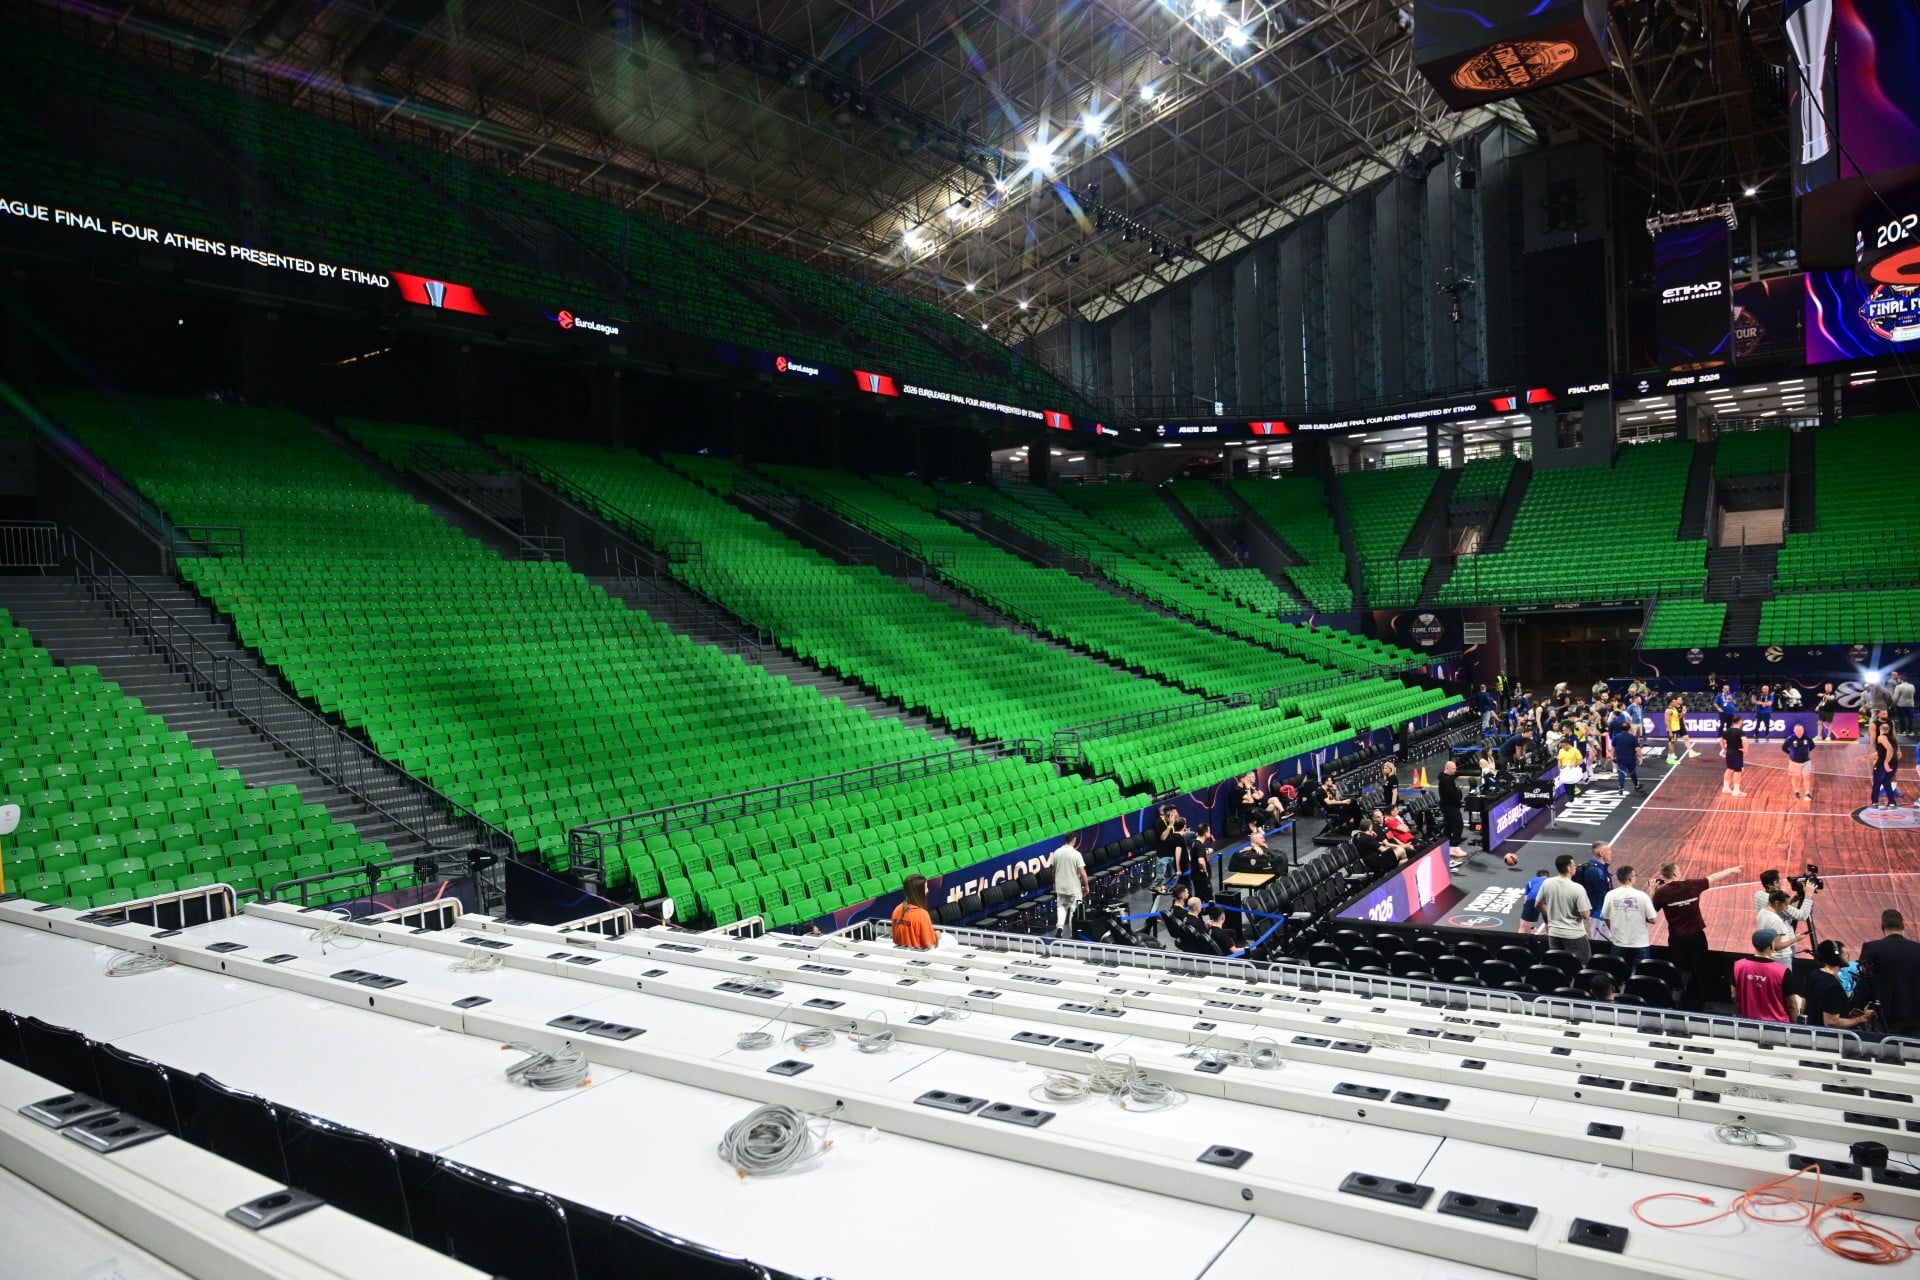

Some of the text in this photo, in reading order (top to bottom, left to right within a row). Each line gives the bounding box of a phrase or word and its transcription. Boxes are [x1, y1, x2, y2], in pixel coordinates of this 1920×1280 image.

[0, 198, 390, 288] AGUE FINAL FOUR ATHENS PRESENTED BY ETIHAD
[1662, 281, 1722, 298] ETIHAD
[1869, 300, 1908, 317] FINAL
[574, 318, 619, 335] EuroLeague
[1735, 327, 1757, 339] OUR
[787, 361, 819, 376] EuroLeague
[903, 384, 918, 395] 2026
[1567, 383, 1610, 395] FINAL FOUR
[1554, 789, 1630, 826] ATHENS
[1368, 895, 1394, 922] 2026
